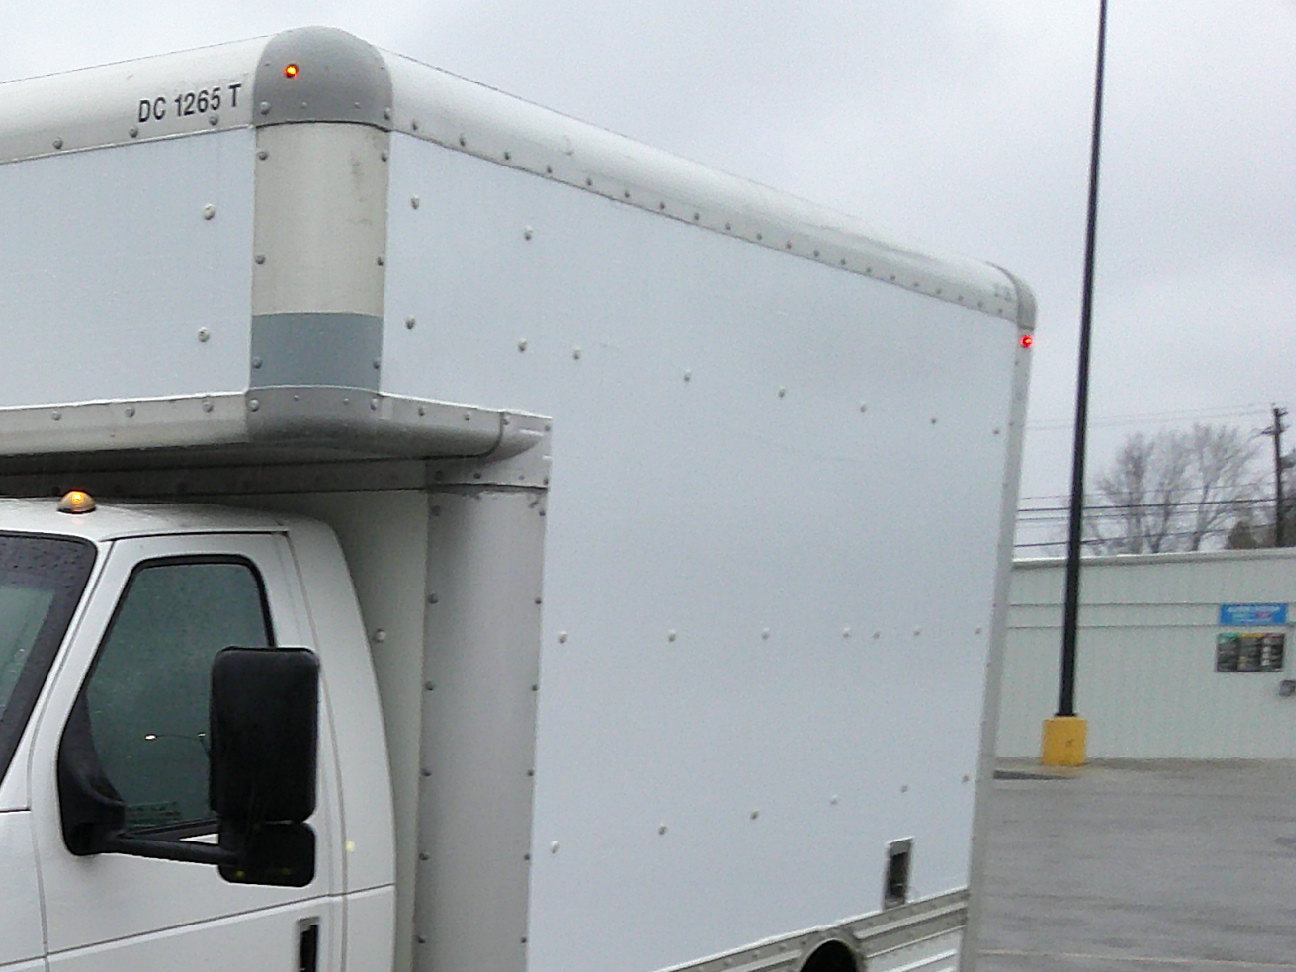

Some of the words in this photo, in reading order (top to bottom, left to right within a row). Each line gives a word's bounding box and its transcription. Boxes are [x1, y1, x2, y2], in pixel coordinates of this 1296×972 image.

[138, 97, 166, 123] DC
[174, 86, 221, 117] 1265
[228, 83, 242, 107] T
